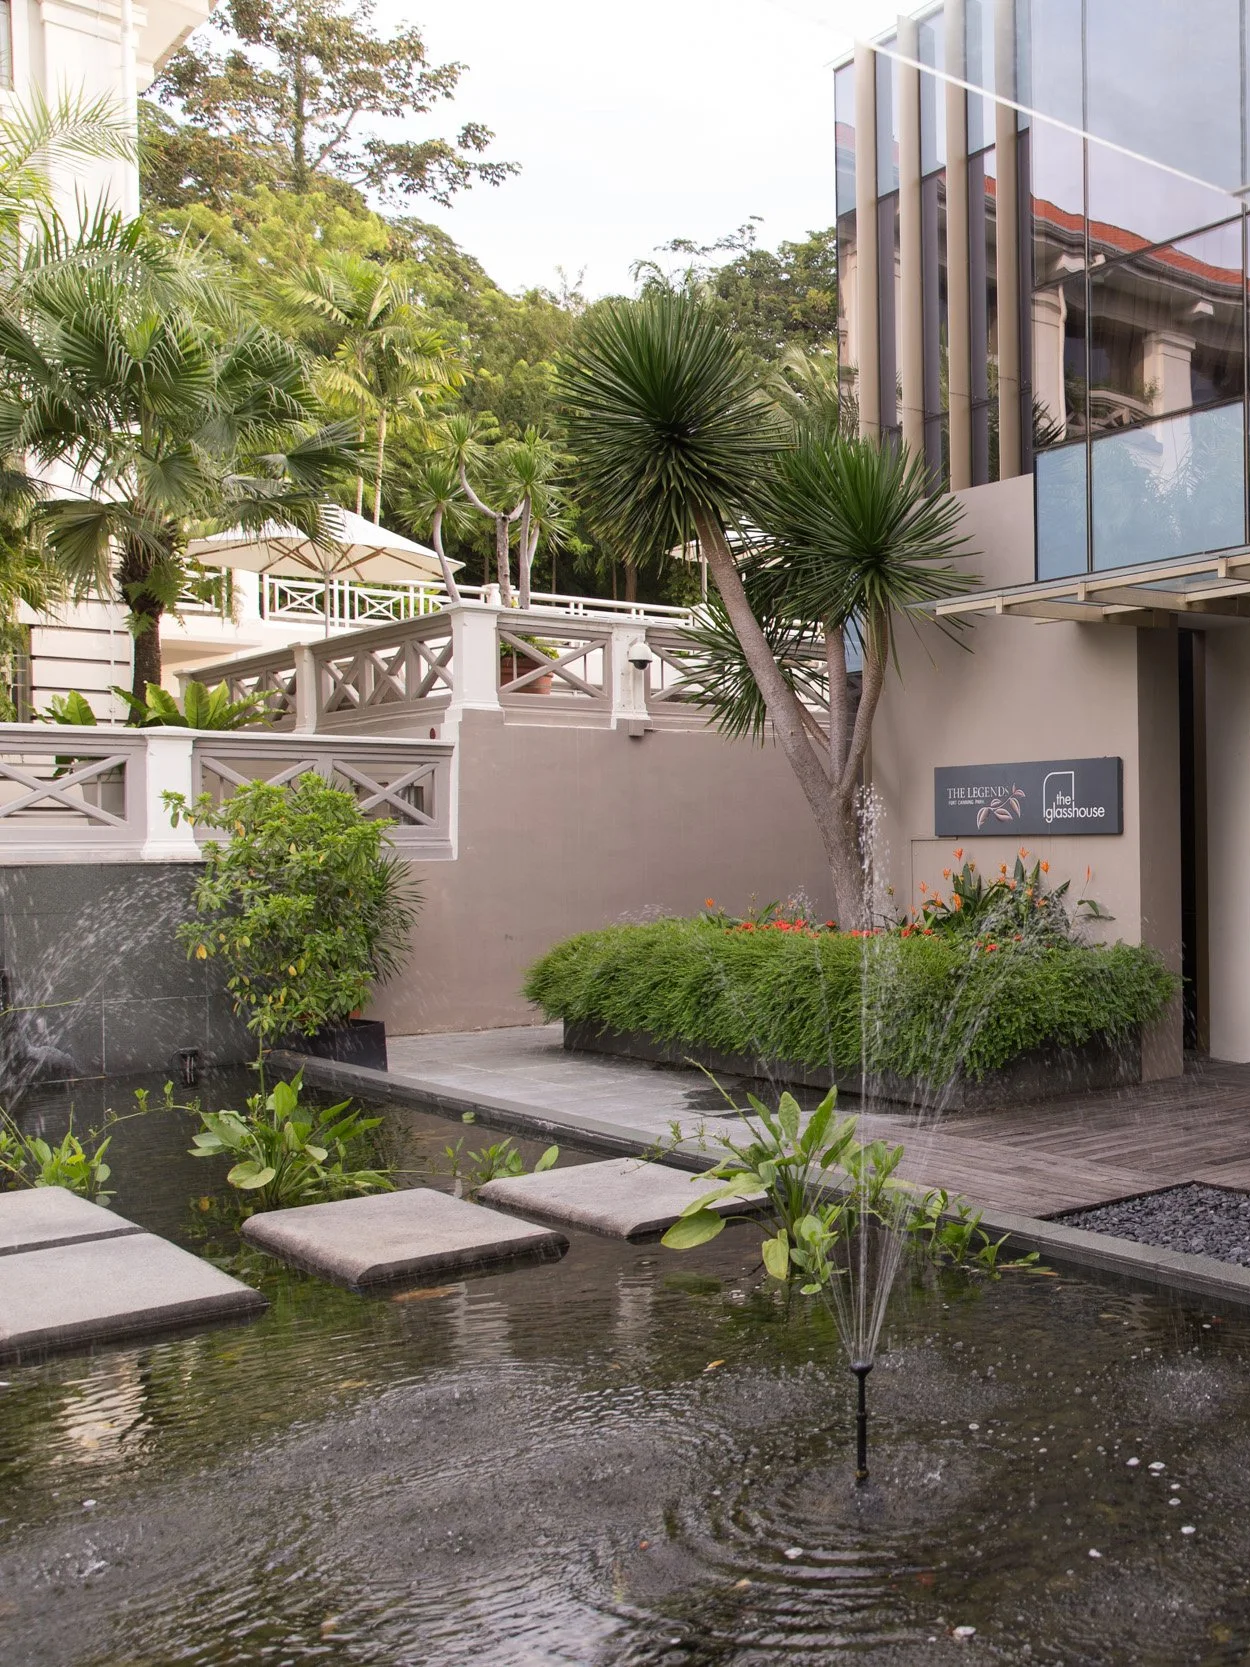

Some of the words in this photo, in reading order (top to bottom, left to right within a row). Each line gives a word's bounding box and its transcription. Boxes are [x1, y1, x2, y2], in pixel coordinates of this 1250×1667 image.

[947, 787, 966, 799] THE
[967, 784, 1010, 798] LEGENDS
[1056, 791, 1072, 806] the
[1046, 800, 1105, 824] glasshouse
